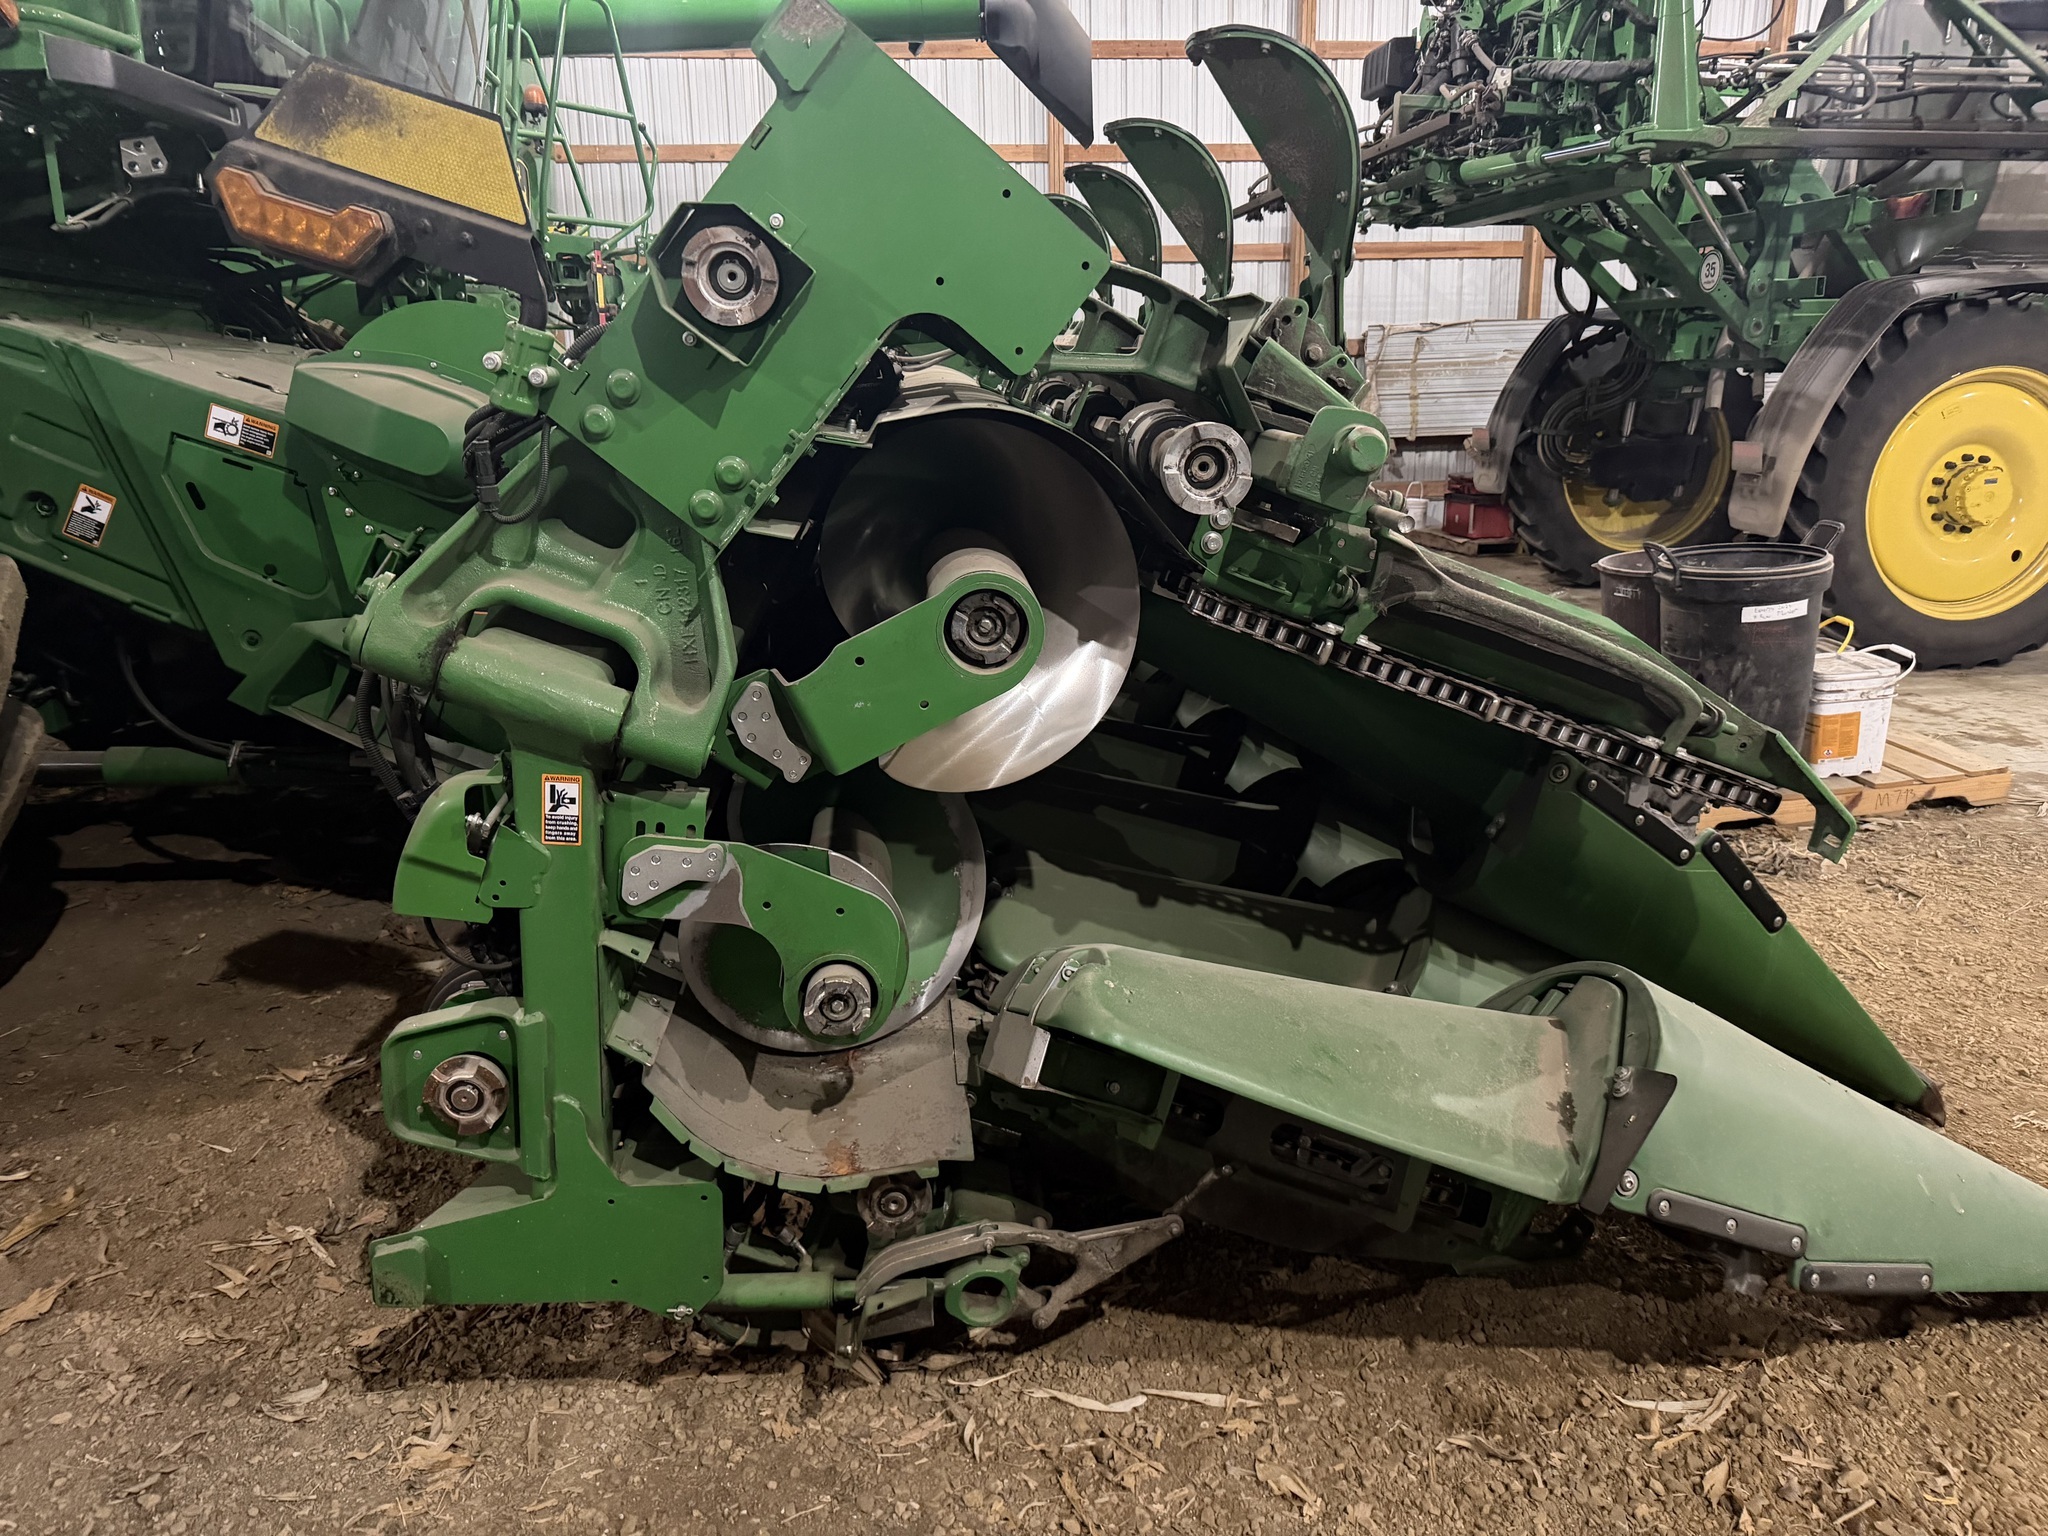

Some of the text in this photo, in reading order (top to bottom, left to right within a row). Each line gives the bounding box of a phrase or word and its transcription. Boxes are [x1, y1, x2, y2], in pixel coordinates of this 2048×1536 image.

[1704, 262, 1716, 278] 35
[250, 418, 276, 431] WARNING
[656, 588, 672, 614] CN
[1874, 792, 1890, 810] M
